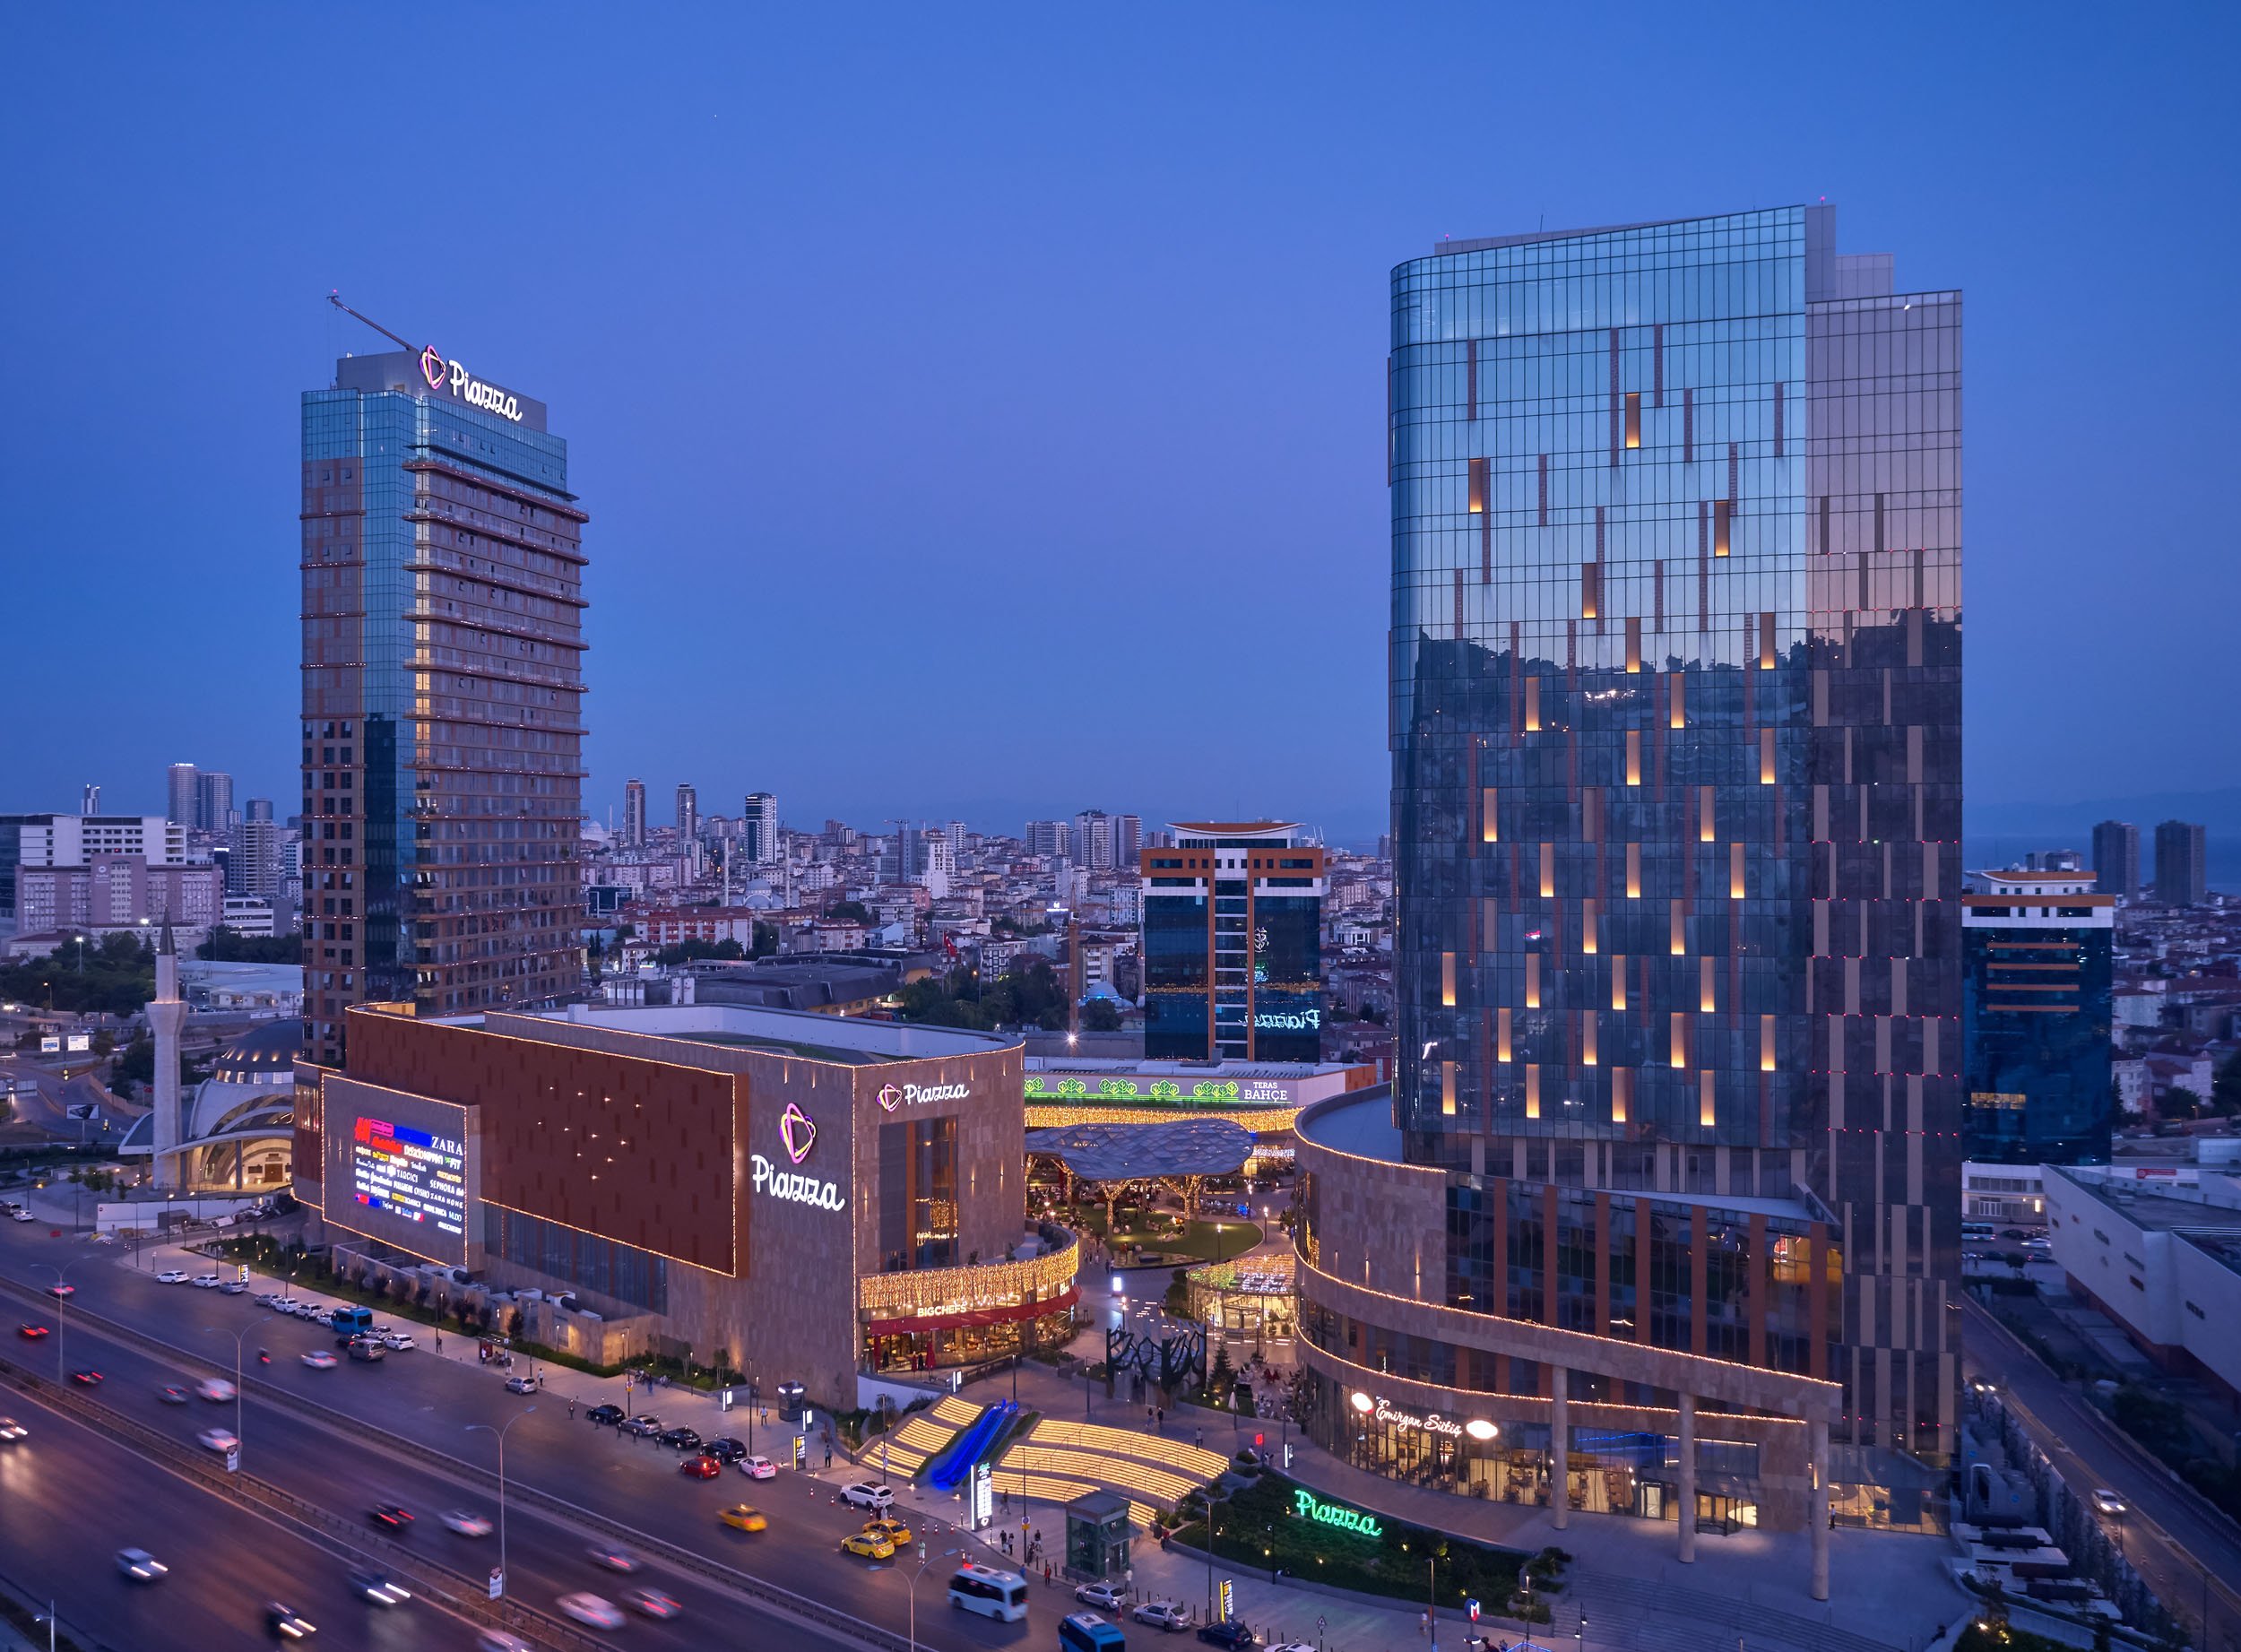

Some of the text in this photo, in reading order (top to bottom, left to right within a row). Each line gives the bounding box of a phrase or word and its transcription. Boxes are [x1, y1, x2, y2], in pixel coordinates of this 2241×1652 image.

[449, 359, 523, 421] Piazza
[903, 1084, 970, 1105] Piazza
[1244, 1090, 1287, 1103] BAHÇE
[431, 1136, 463, 1156] ZARA
[751, 1155, 845, 1212] Piazza
[430, 1193, 446, 1203] ZARA
[917, 1304, 967, 1318] BIGCHEFS
[1376, 1399, 1423, 1431] Emirgan
[1294, 1490, 1382, 1536] Piazza
[1470, 1601, 1480, 1618] M
